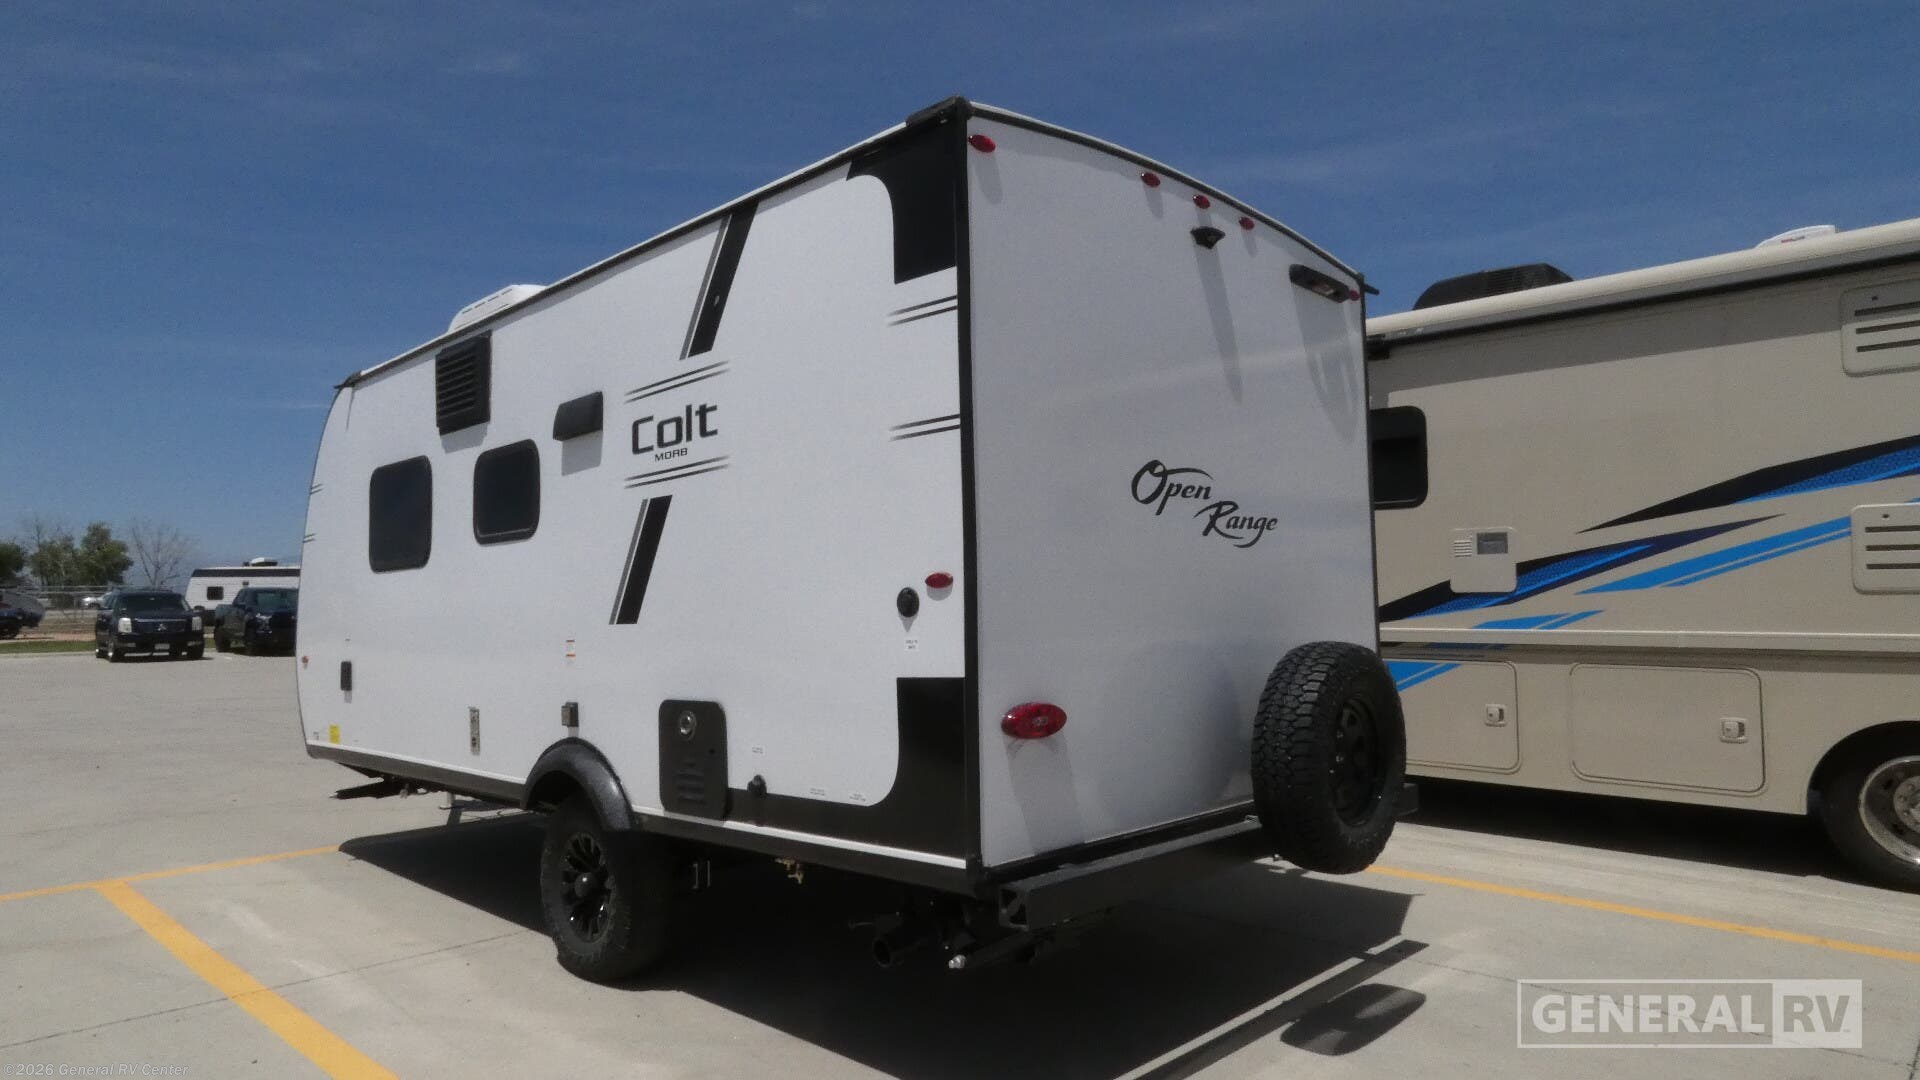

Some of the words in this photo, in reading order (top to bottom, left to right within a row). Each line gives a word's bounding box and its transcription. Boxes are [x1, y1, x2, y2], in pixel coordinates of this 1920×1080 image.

[632, 403, 718, 455] Colt
[1131, 459, 1214, 516] Open
[1193, 500, 1278, 548] Range
